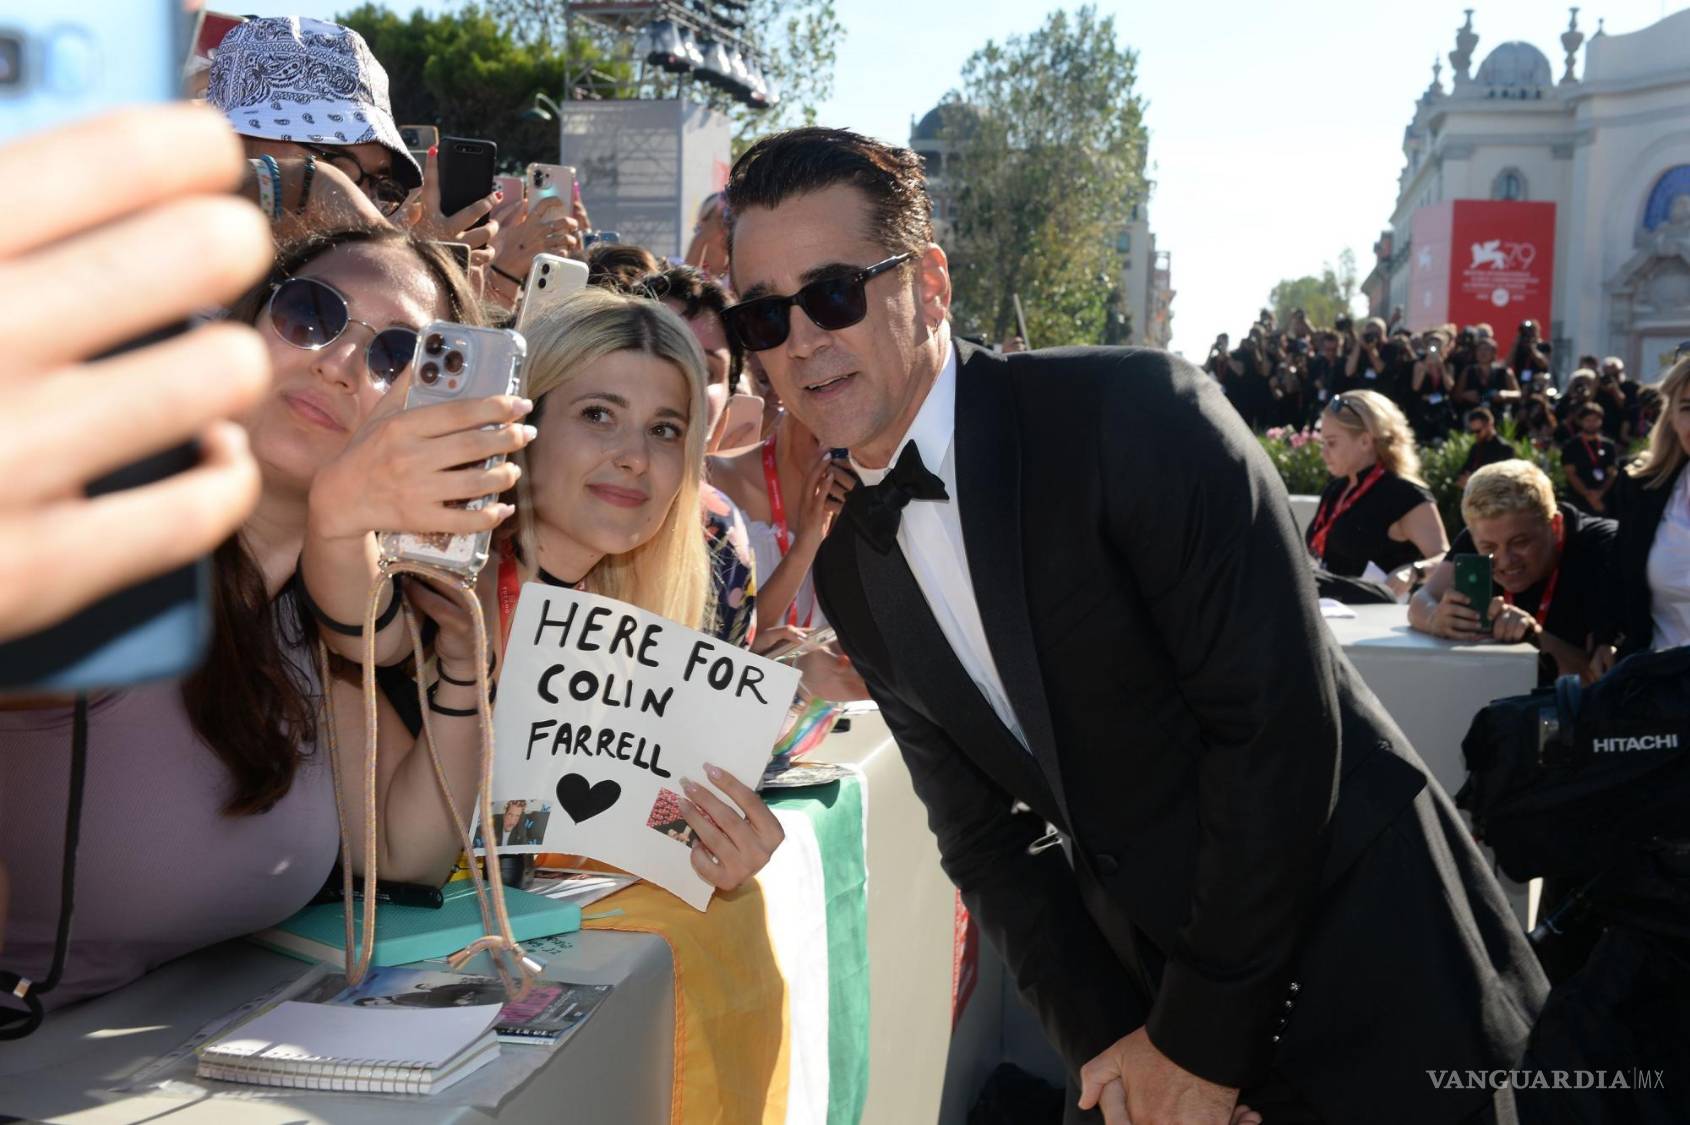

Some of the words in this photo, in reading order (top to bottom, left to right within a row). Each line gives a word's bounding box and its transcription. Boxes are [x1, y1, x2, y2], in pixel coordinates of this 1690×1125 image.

[534, 599, 663, 668] HERE
[683, 640, 769, 705] FOR
[537, 663, 675, 718] COLIN
[526, 719, 672, 778] FARRELL
[1593, 733, 1678, 753] HITACHI
